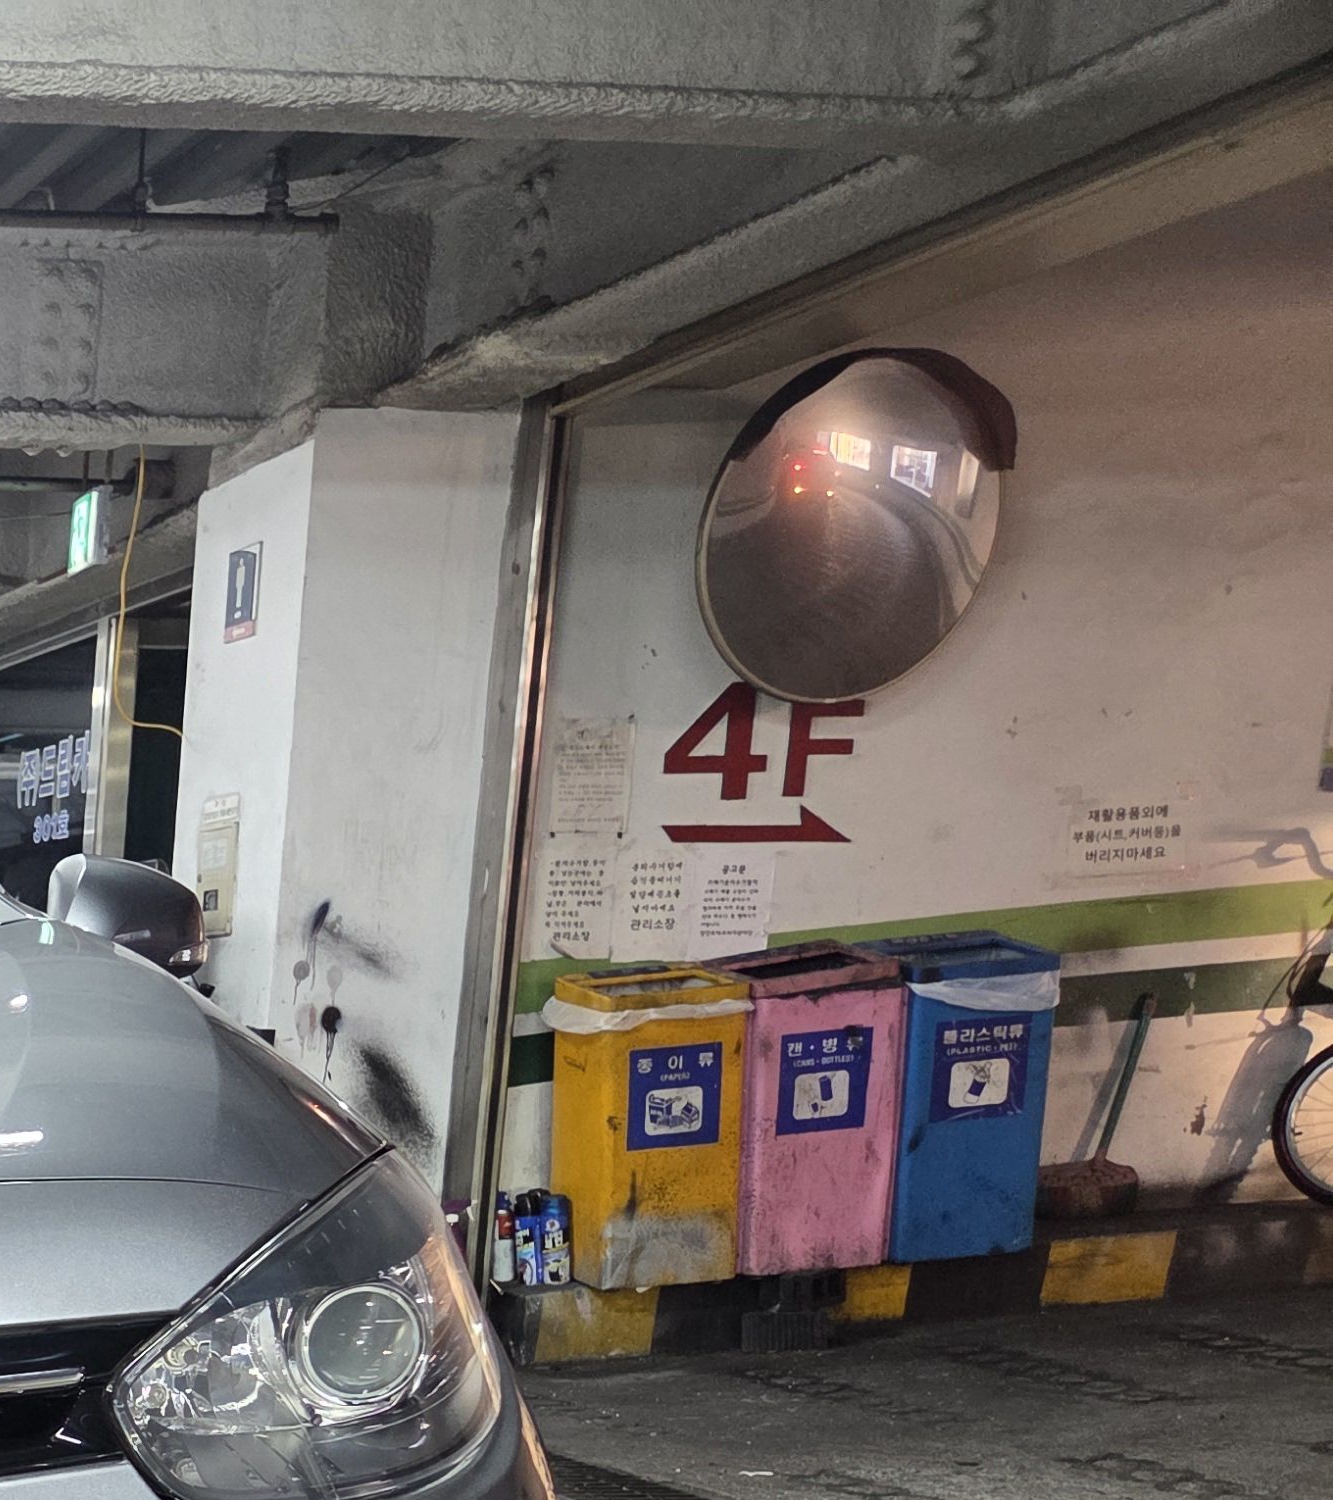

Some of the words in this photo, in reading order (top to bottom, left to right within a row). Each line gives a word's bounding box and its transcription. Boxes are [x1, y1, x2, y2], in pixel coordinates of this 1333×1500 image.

[663, 681, 866, 800] 4F
[1084, 845, 1167, 864] 버리지마세요
[630, 917, 676, 931] 관리소장
